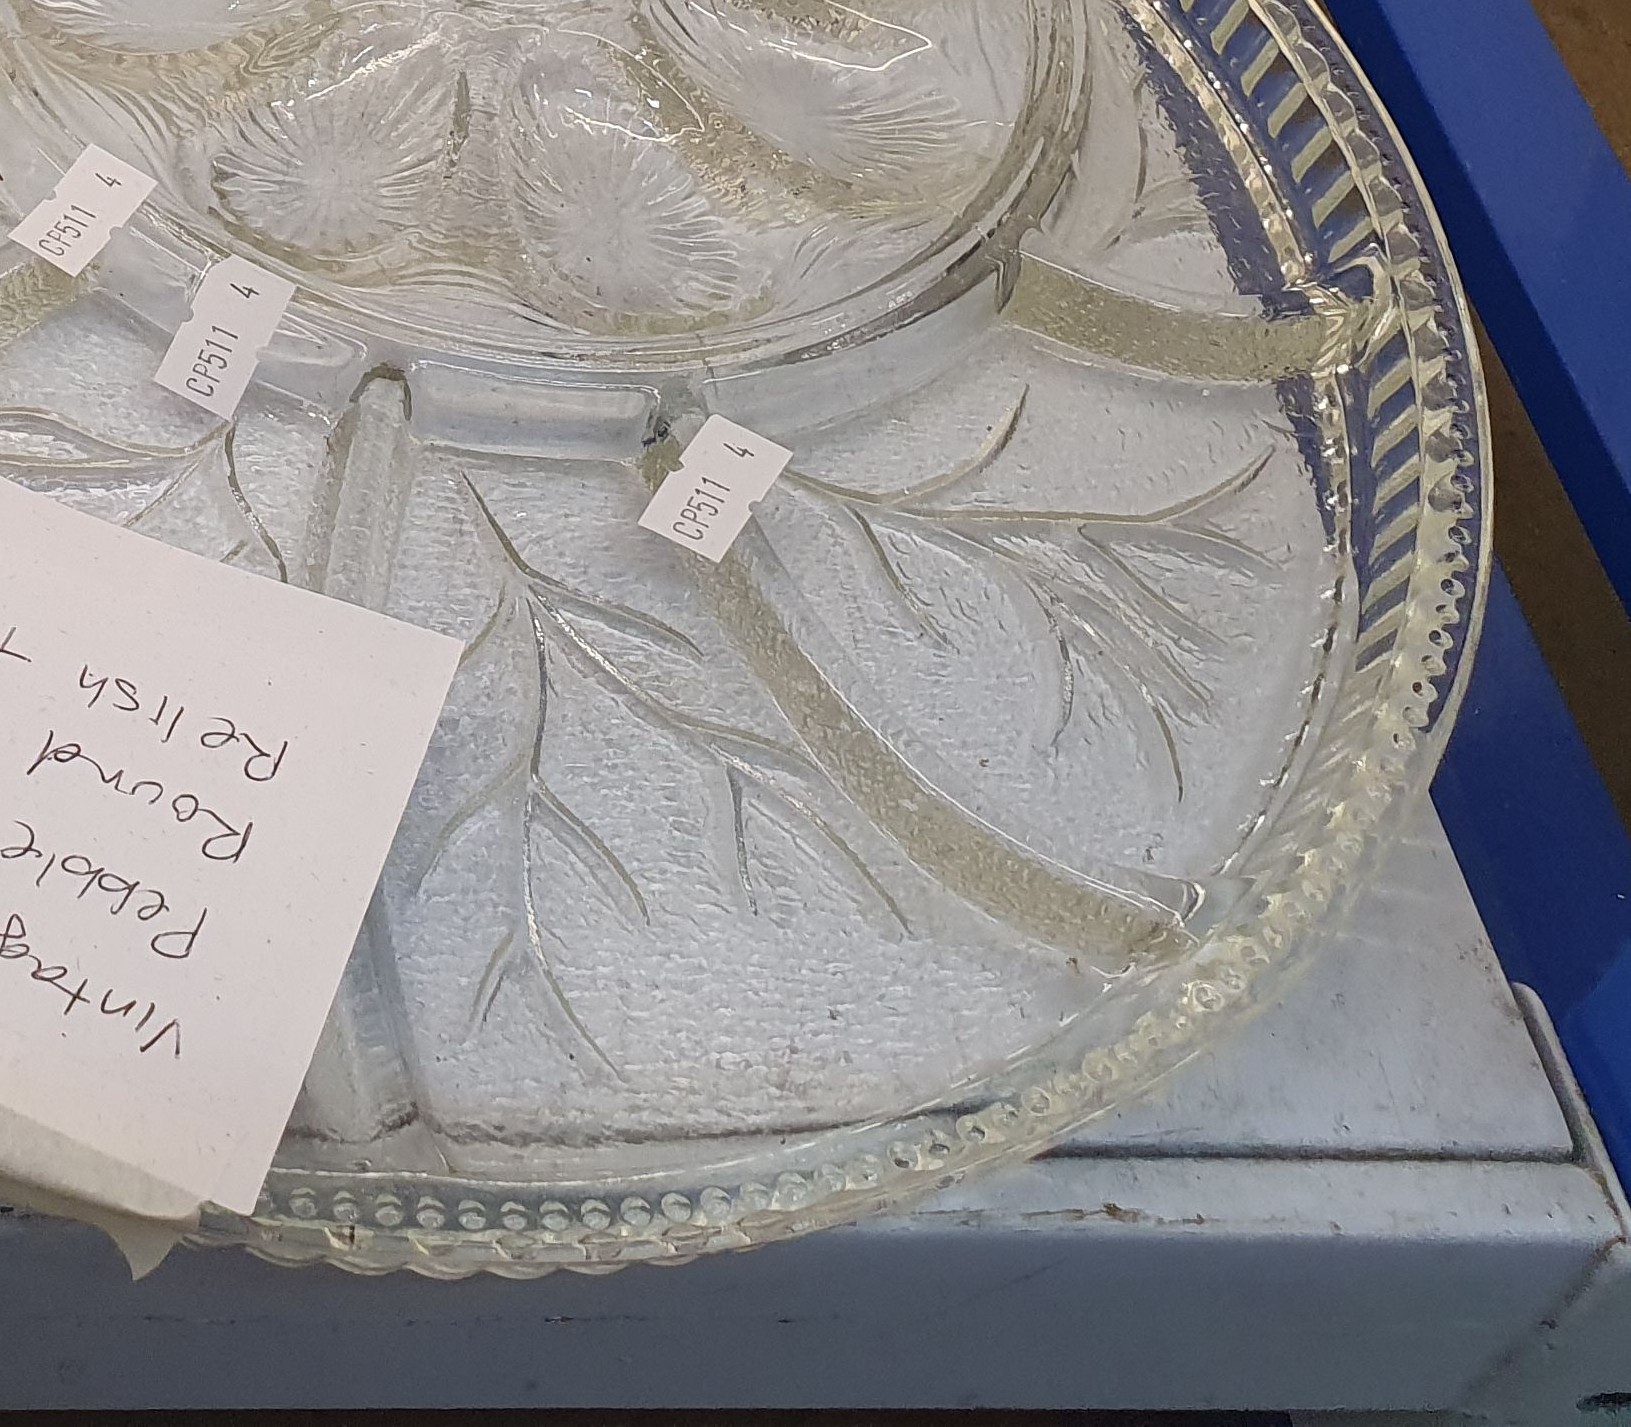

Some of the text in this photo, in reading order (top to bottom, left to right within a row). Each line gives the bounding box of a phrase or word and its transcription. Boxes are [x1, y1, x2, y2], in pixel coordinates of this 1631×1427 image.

[38, 172, 122, 256] CP511 4
[185, 282, 260, 397] CP511 4
[672, 442, 755, 541] CP511 4
[79, 663, 289, 782] Relish
[26, 729, 254, 864] Round
[0, 820, 208, 960] Pebble
